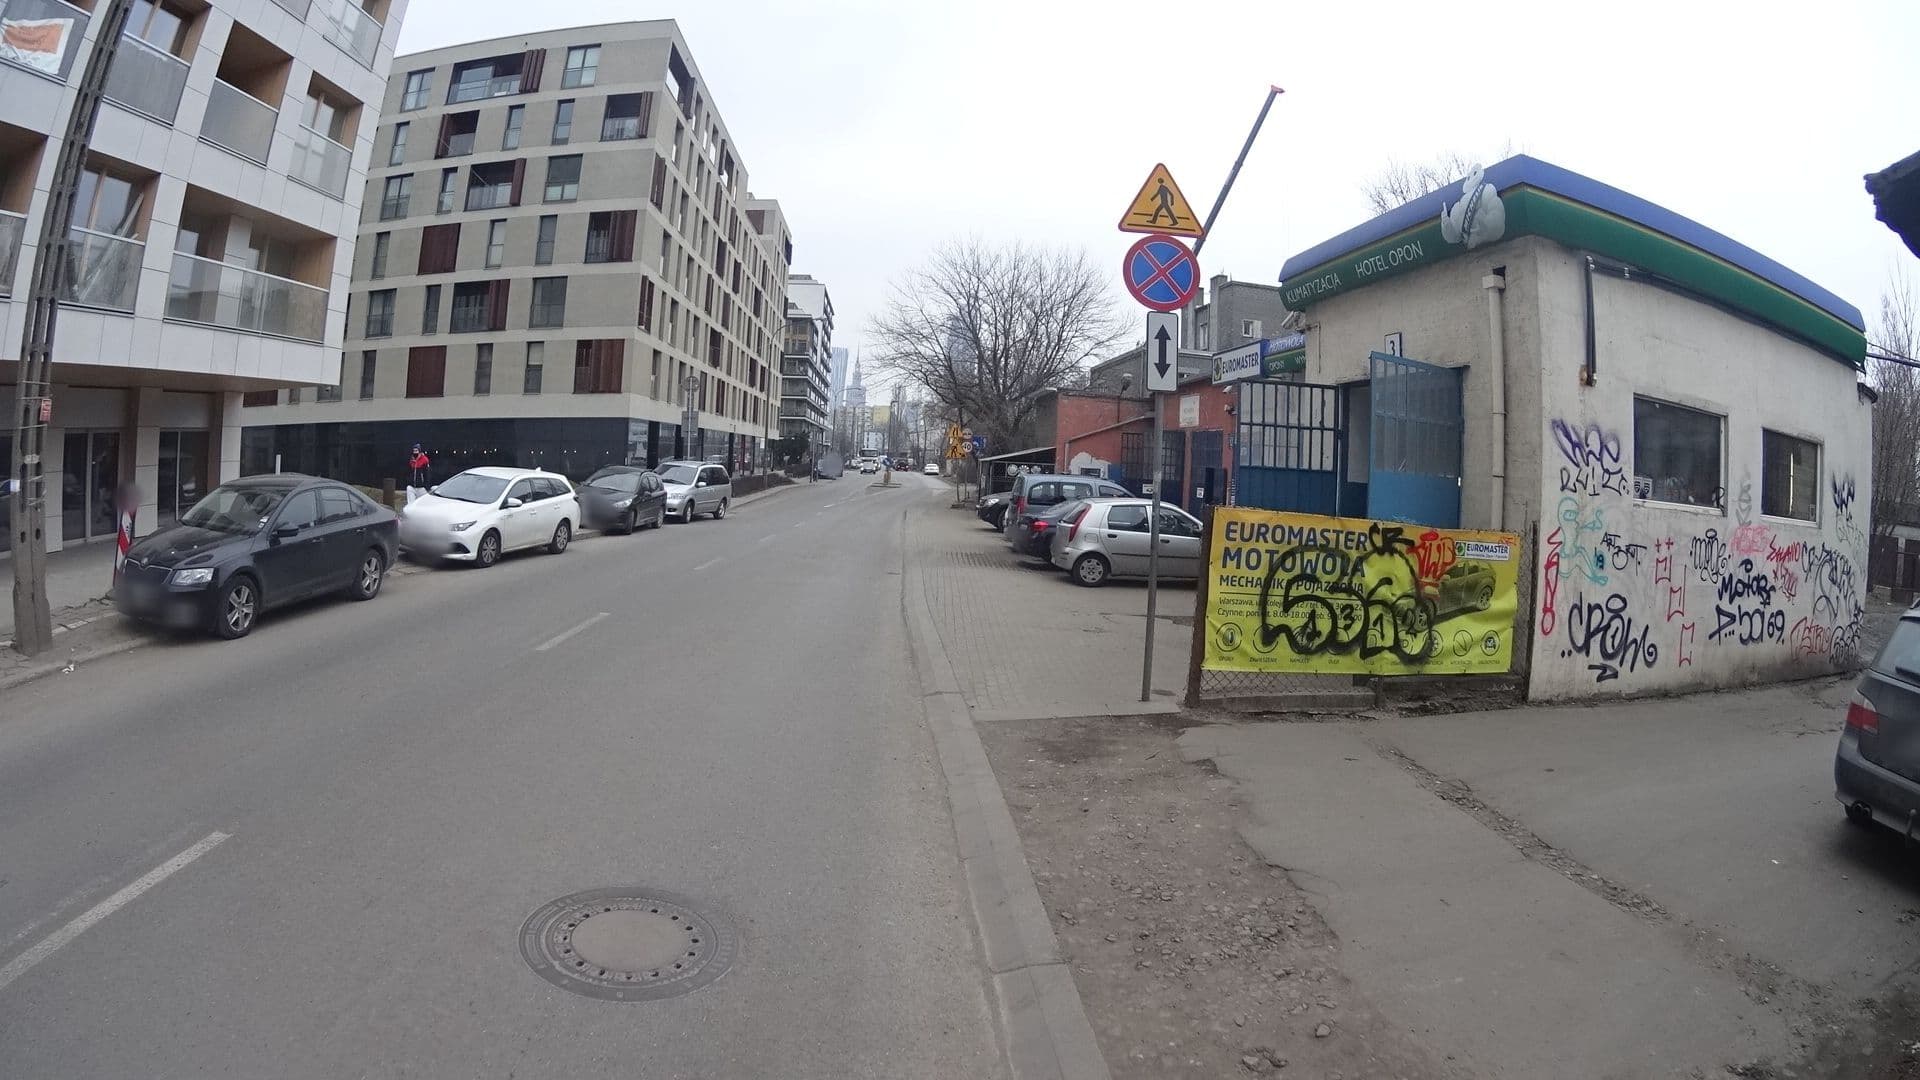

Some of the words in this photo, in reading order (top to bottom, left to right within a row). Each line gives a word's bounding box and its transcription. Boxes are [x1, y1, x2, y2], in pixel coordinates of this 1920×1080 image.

[1354, 255, 1389, 279] HOTEL
[1389, 240, 1424, 266] OPON
[1286, 272, 1342, 304] KLIMATYZACJA
[1222, 351, 1259, 375] EUROMASTER
[1225, 521, 1368, 551] EUROMASTER
[1466, 543, 1509, 554] EUROMASTER
